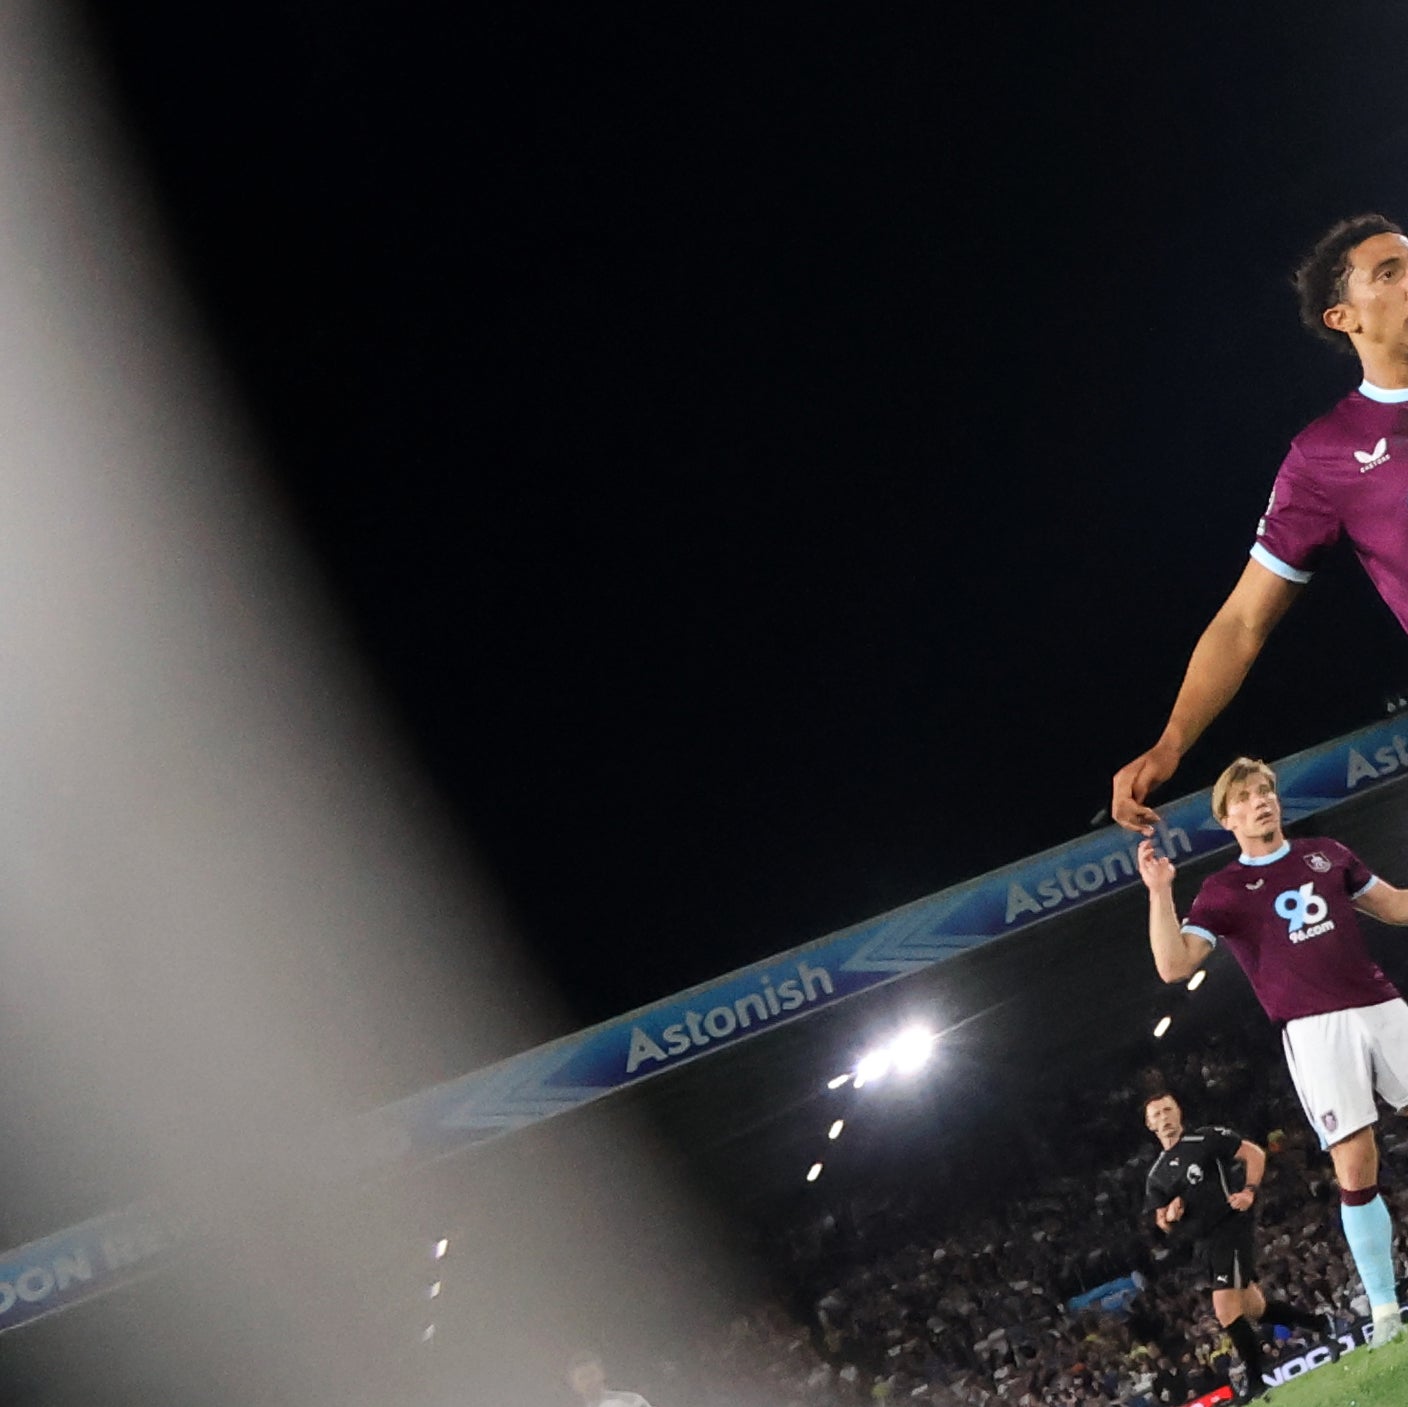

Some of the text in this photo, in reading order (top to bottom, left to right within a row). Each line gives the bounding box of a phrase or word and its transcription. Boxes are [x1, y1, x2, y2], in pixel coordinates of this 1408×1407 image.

[1274, 881, 1328, 933] 96
[1289, 920, 1334, 944] 96.com
[626, 960, 834, 1073] Astonish
